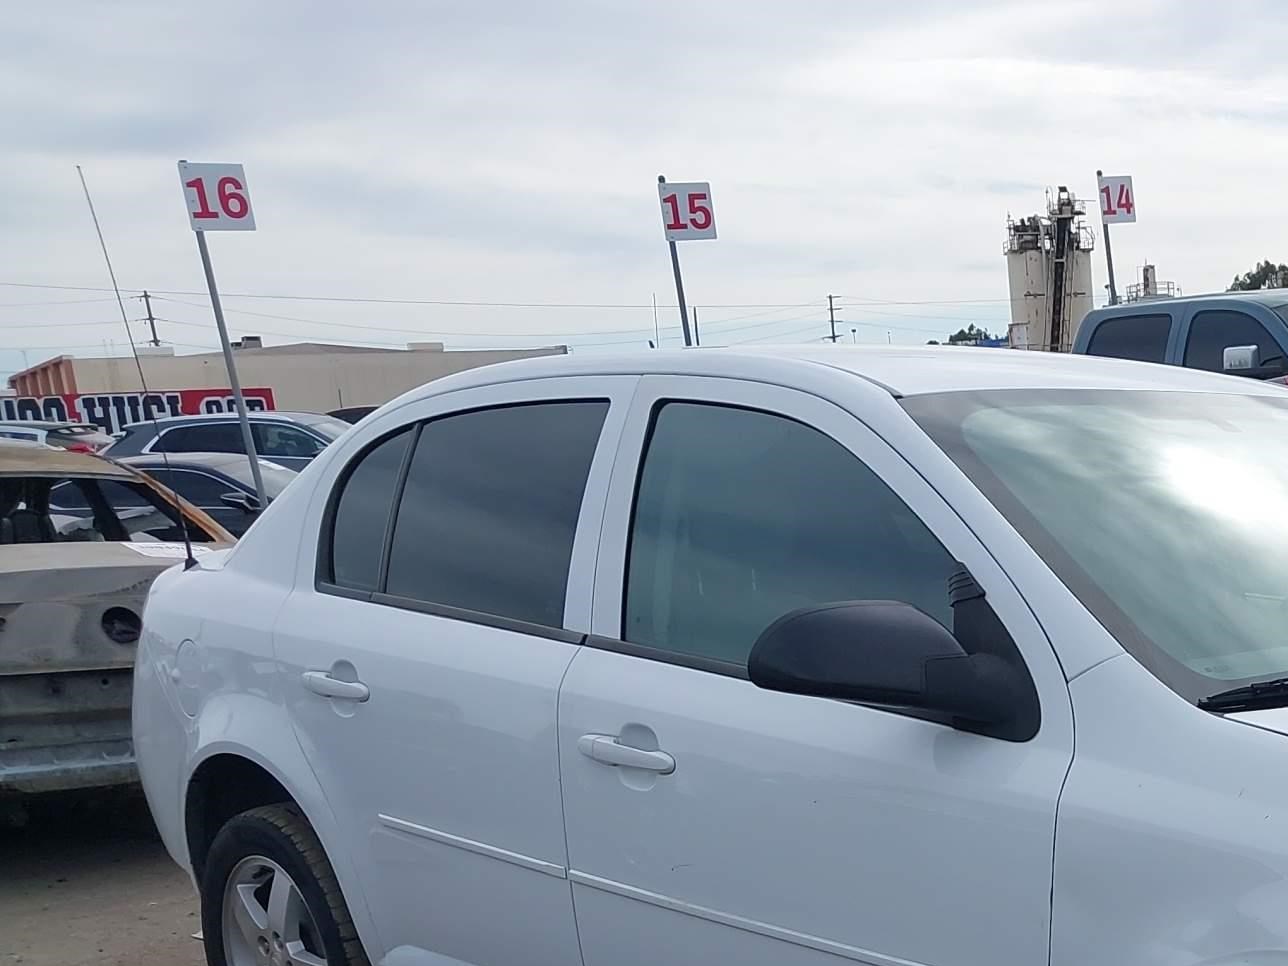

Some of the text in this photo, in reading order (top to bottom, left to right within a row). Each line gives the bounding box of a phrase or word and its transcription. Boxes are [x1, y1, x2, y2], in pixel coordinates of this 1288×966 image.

[186, 177, 248, 218] 16
[663, 193, 711, 229] 15
[1101, 184, 1132, 215] 14
